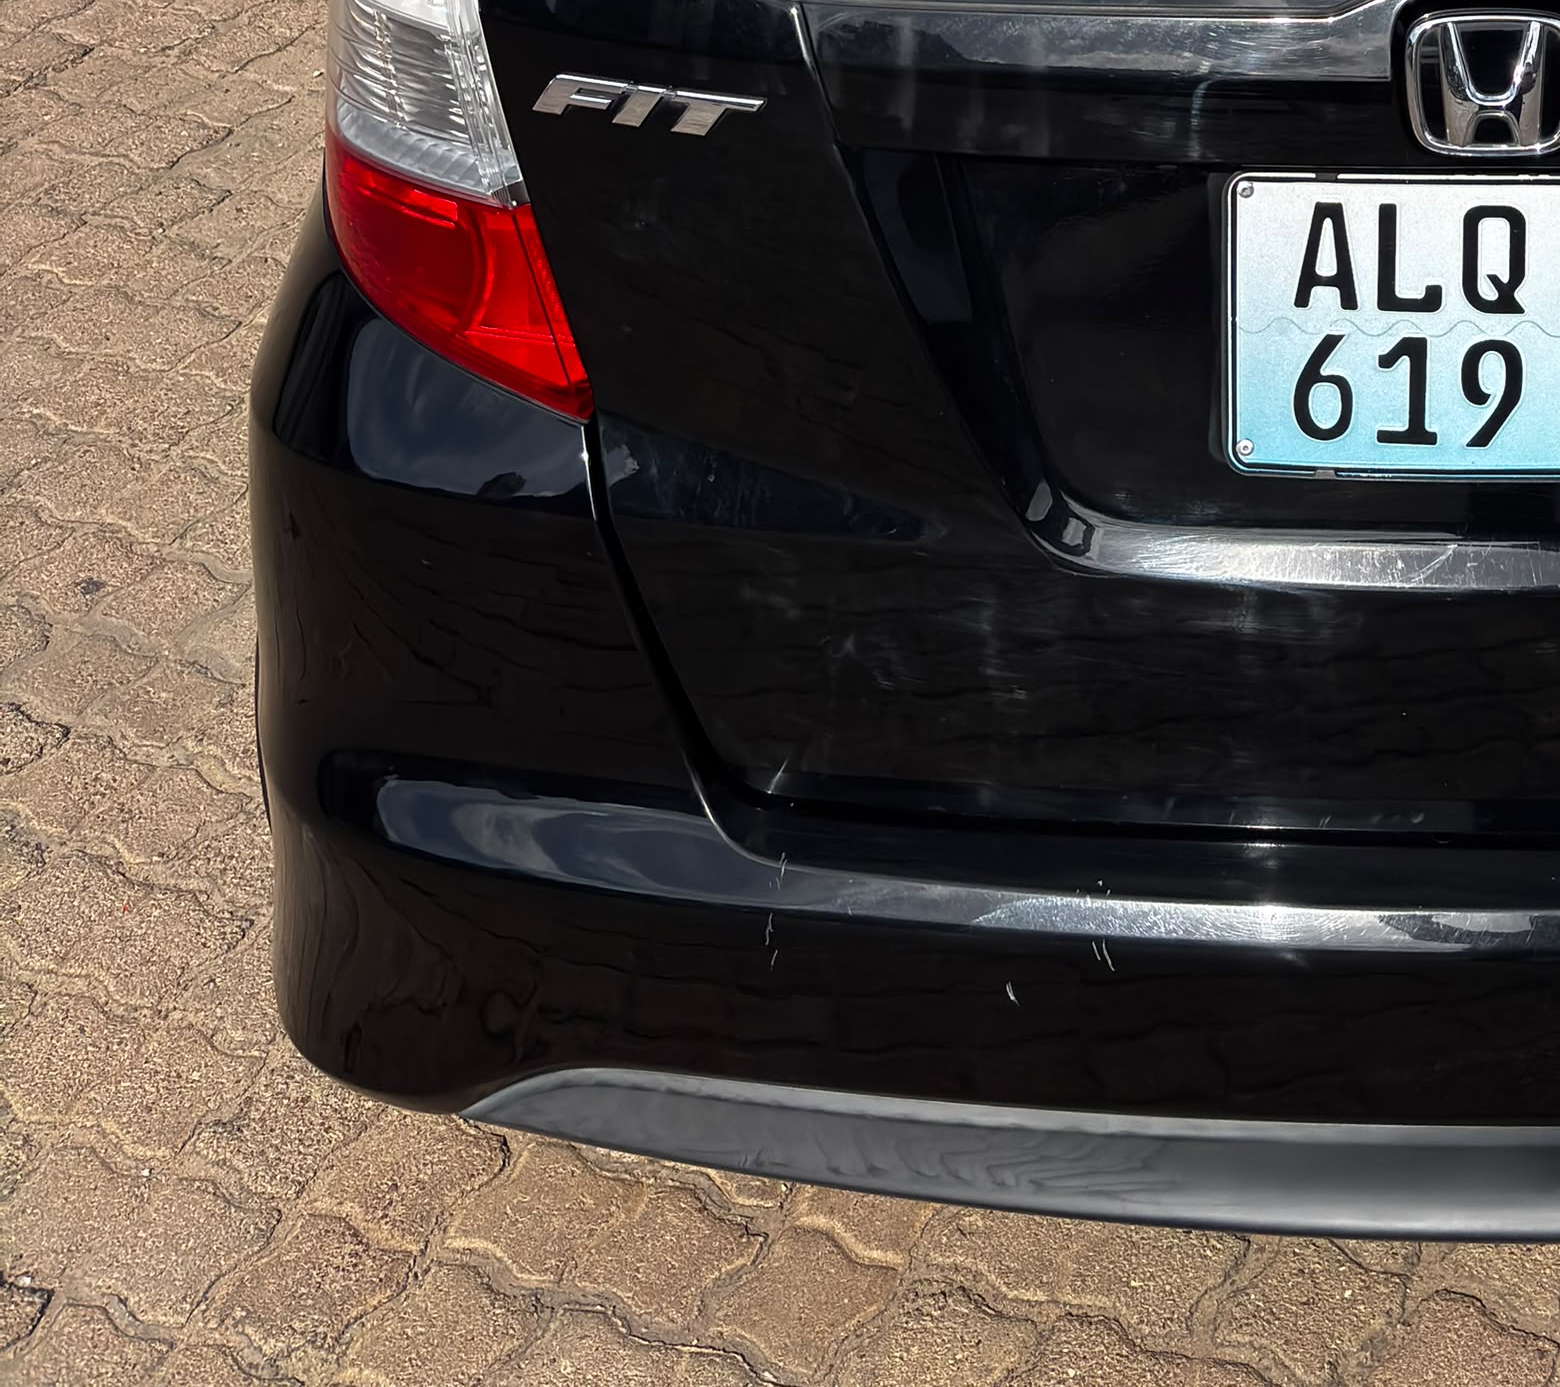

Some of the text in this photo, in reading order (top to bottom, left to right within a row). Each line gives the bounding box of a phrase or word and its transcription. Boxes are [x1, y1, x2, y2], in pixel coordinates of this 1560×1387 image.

[531, 72, 768, 137] FIT
[1293, 201, 1527, 315] ALQ
[1292, 333, 1525, 449] 619
